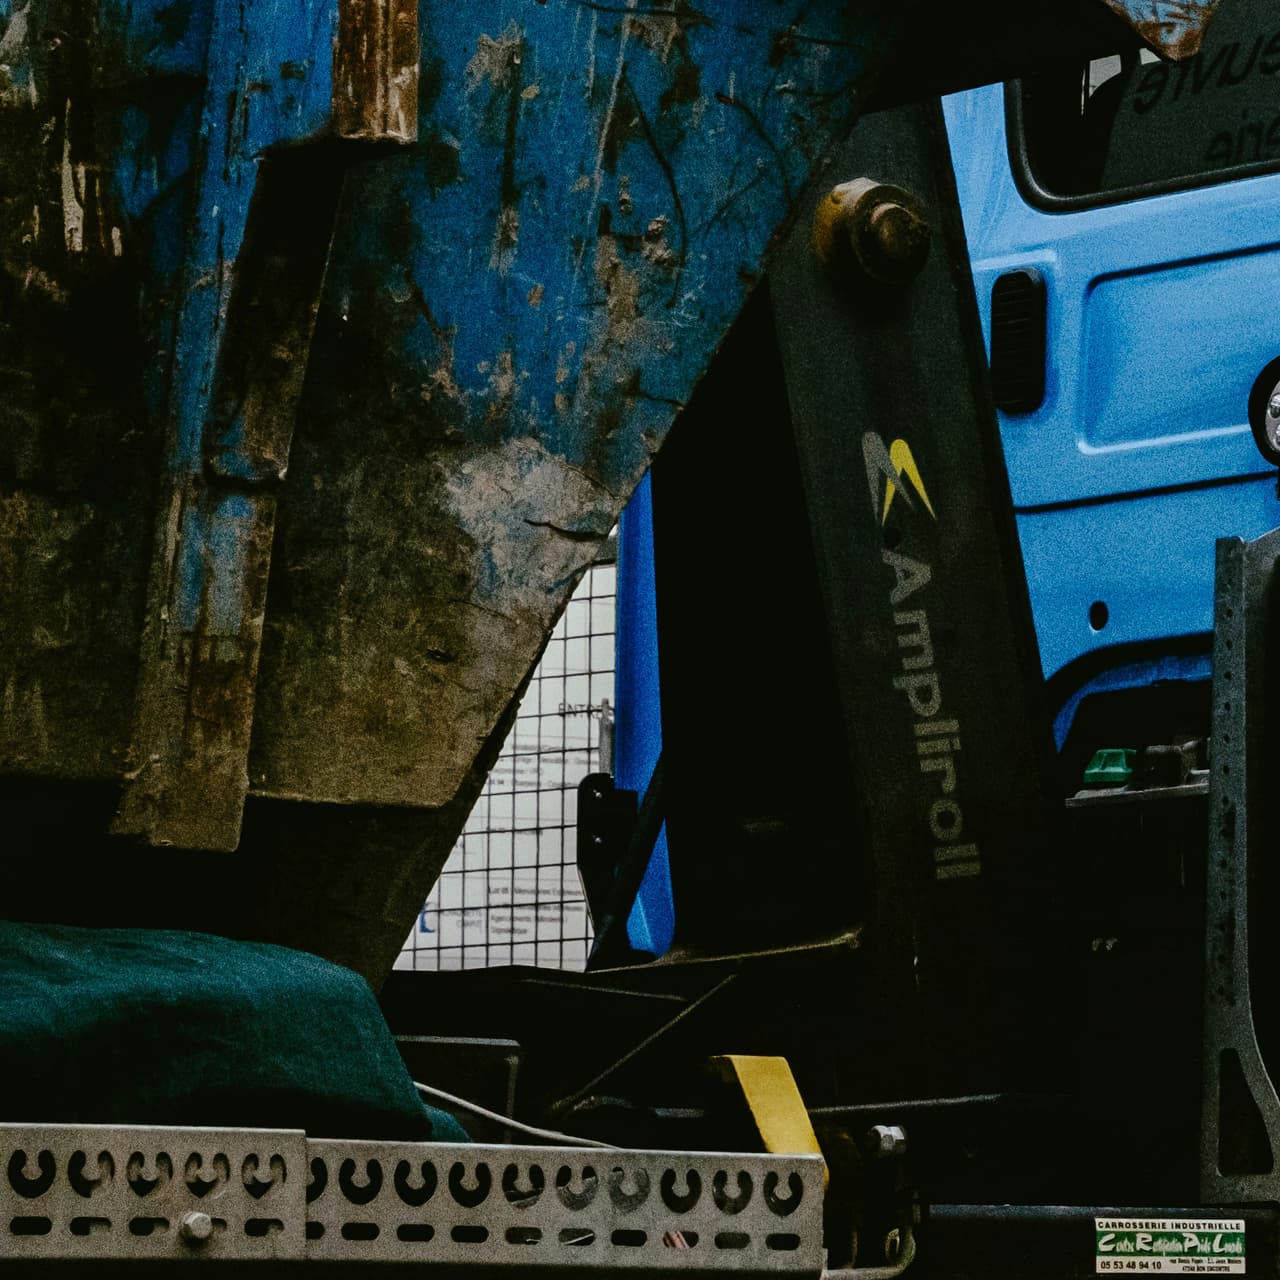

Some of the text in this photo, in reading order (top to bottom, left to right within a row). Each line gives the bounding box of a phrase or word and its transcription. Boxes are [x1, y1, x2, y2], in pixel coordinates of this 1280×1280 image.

[880, 548, 982, 881] Ampliroll
[1097, 1221, 1242, 1231] CARROSSERIE INDUSTRIELLE
[1100, 1261, 1111, 1270] 05
[1113, 1261, 1124, 1270] 53
[1126, 1261, 1137, 1270] 48
[1139, 1261, 1149, 1270] 94
[1152, 1261, 1162, 1270] 10
